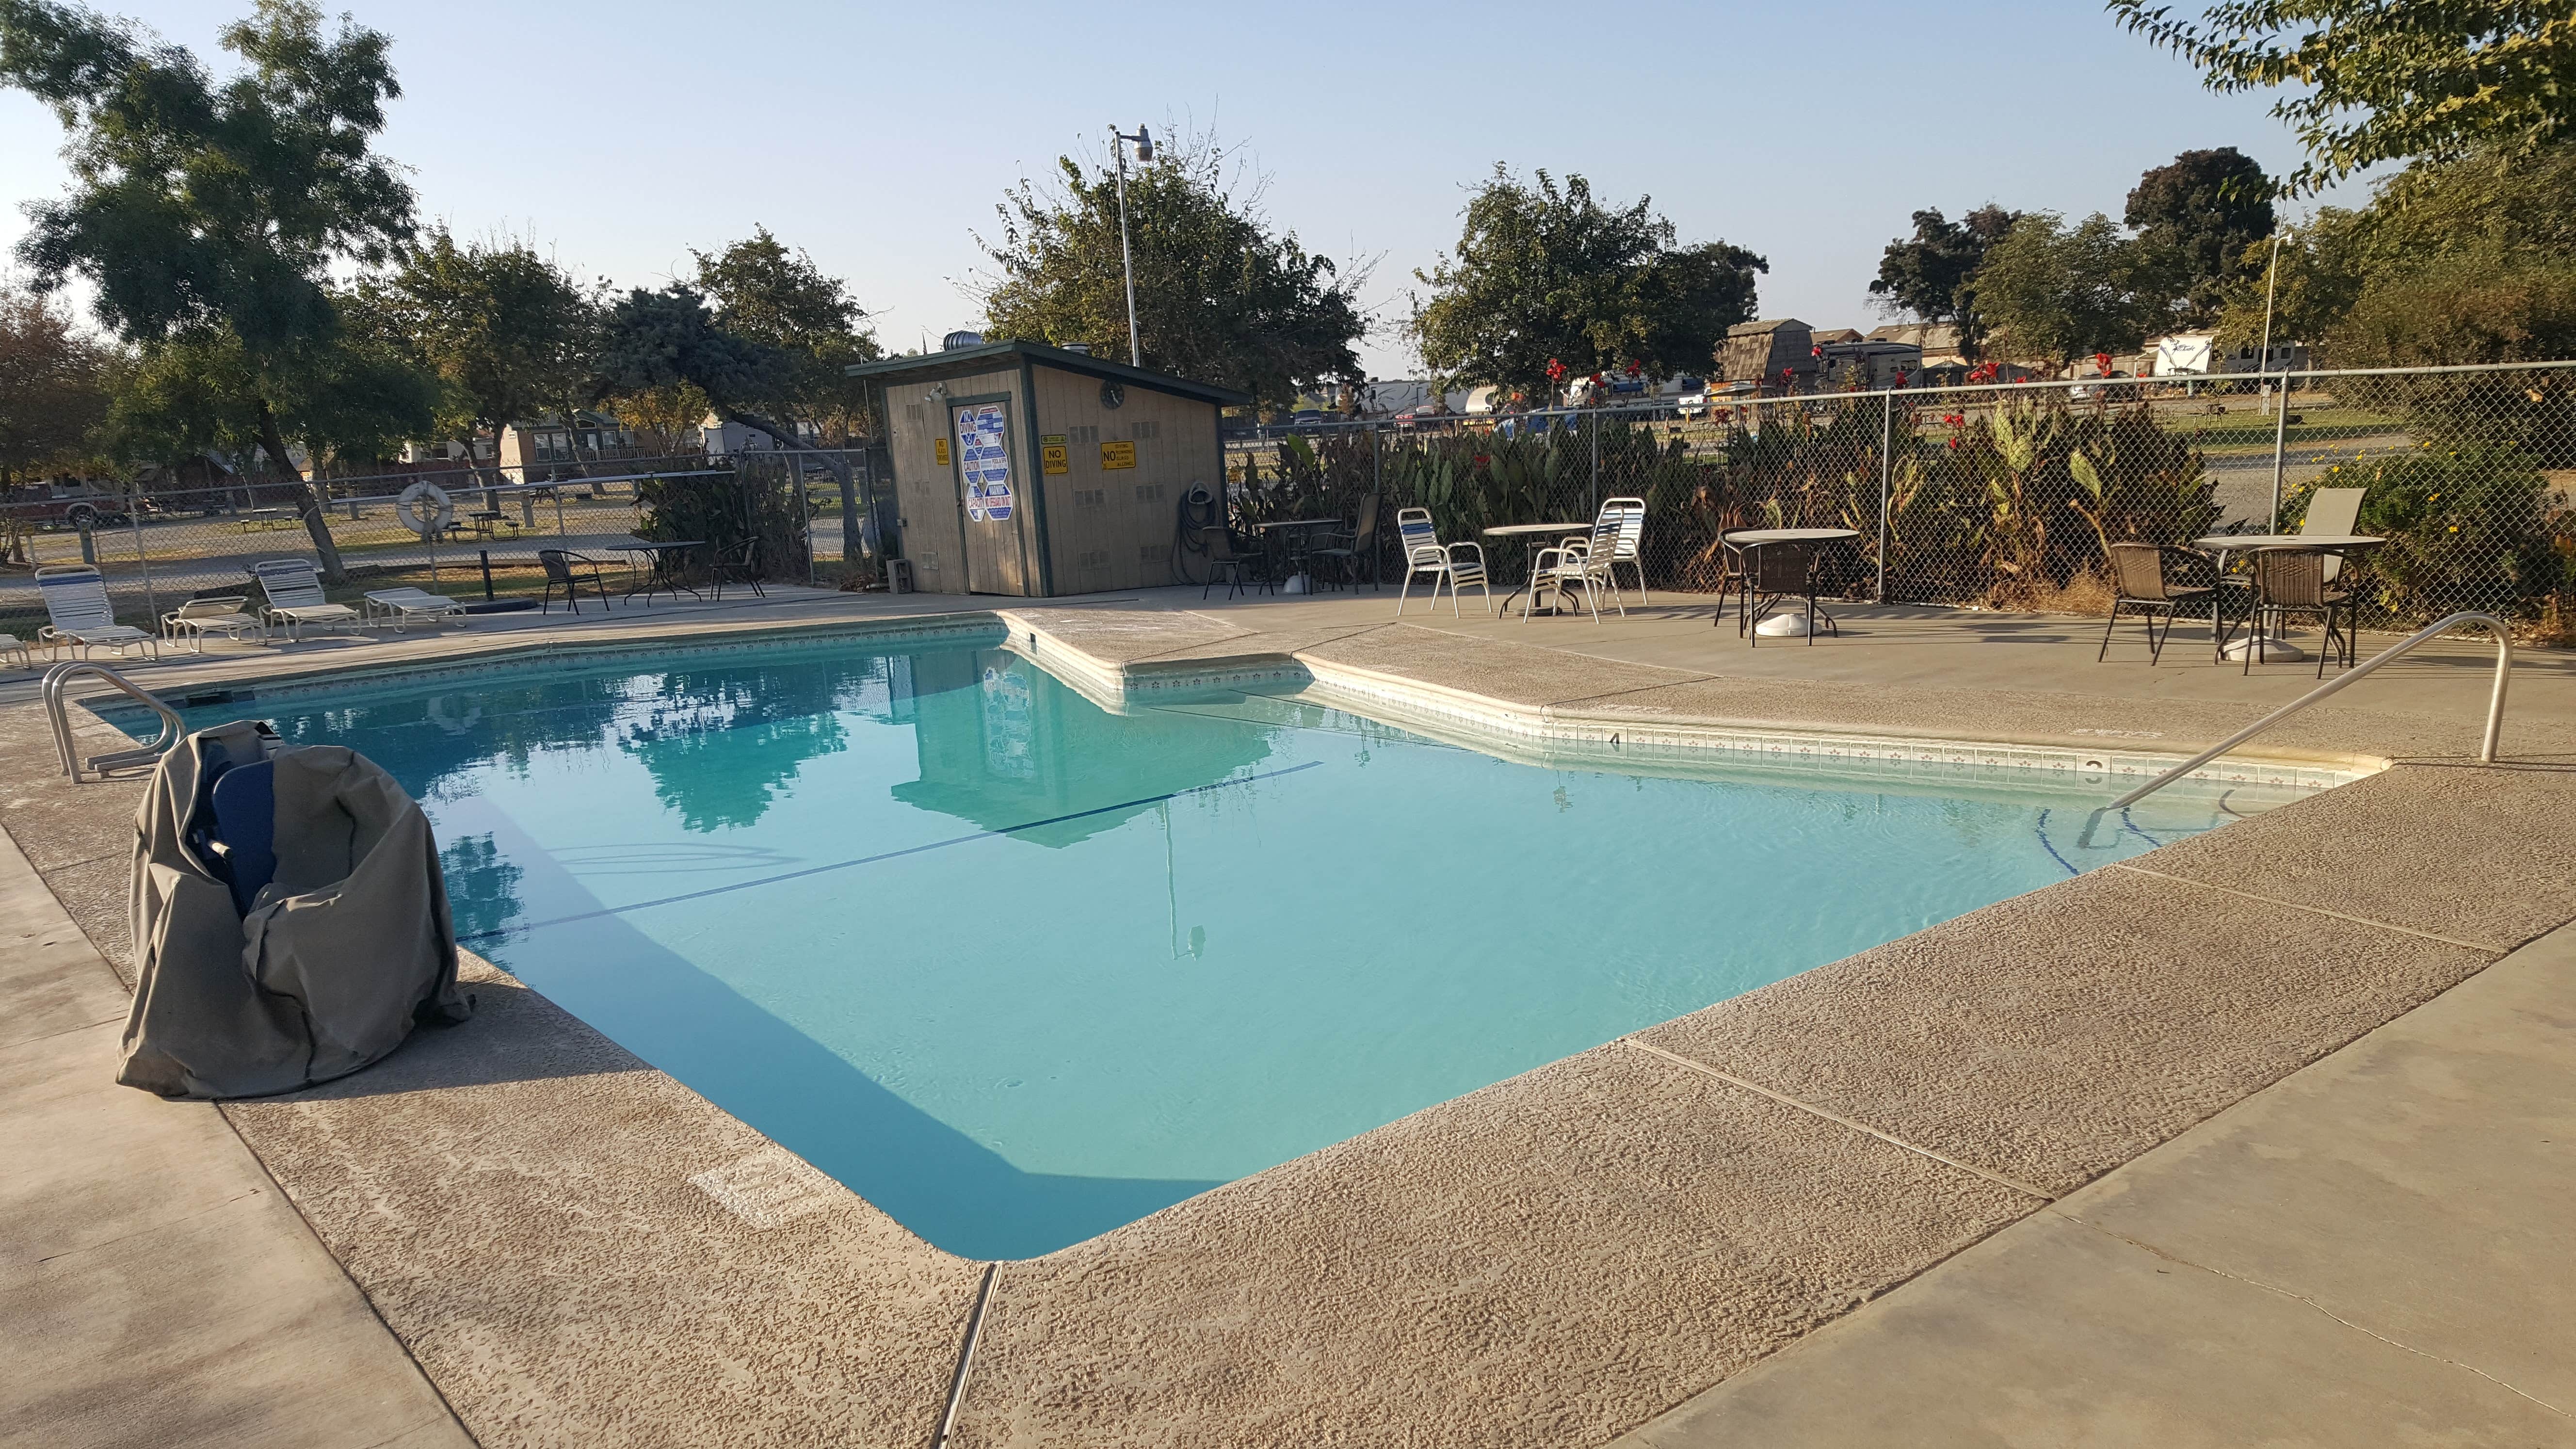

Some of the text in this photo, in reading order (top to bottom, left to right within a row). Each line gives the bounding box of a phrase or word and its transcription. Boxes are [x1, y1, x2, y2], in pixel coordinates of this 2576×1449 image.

[964, 411, 971, 422] NO
[960, 422, 976, 433] DIVING
[1048, 450, 1061, 459] NO
[1103, 451, 1116, 461] NO
[964, 461, 980, 471] CAUTION
[1045, 459, 1066, 468] DIVING
[968, 498, 984, 508] CAPACITY
